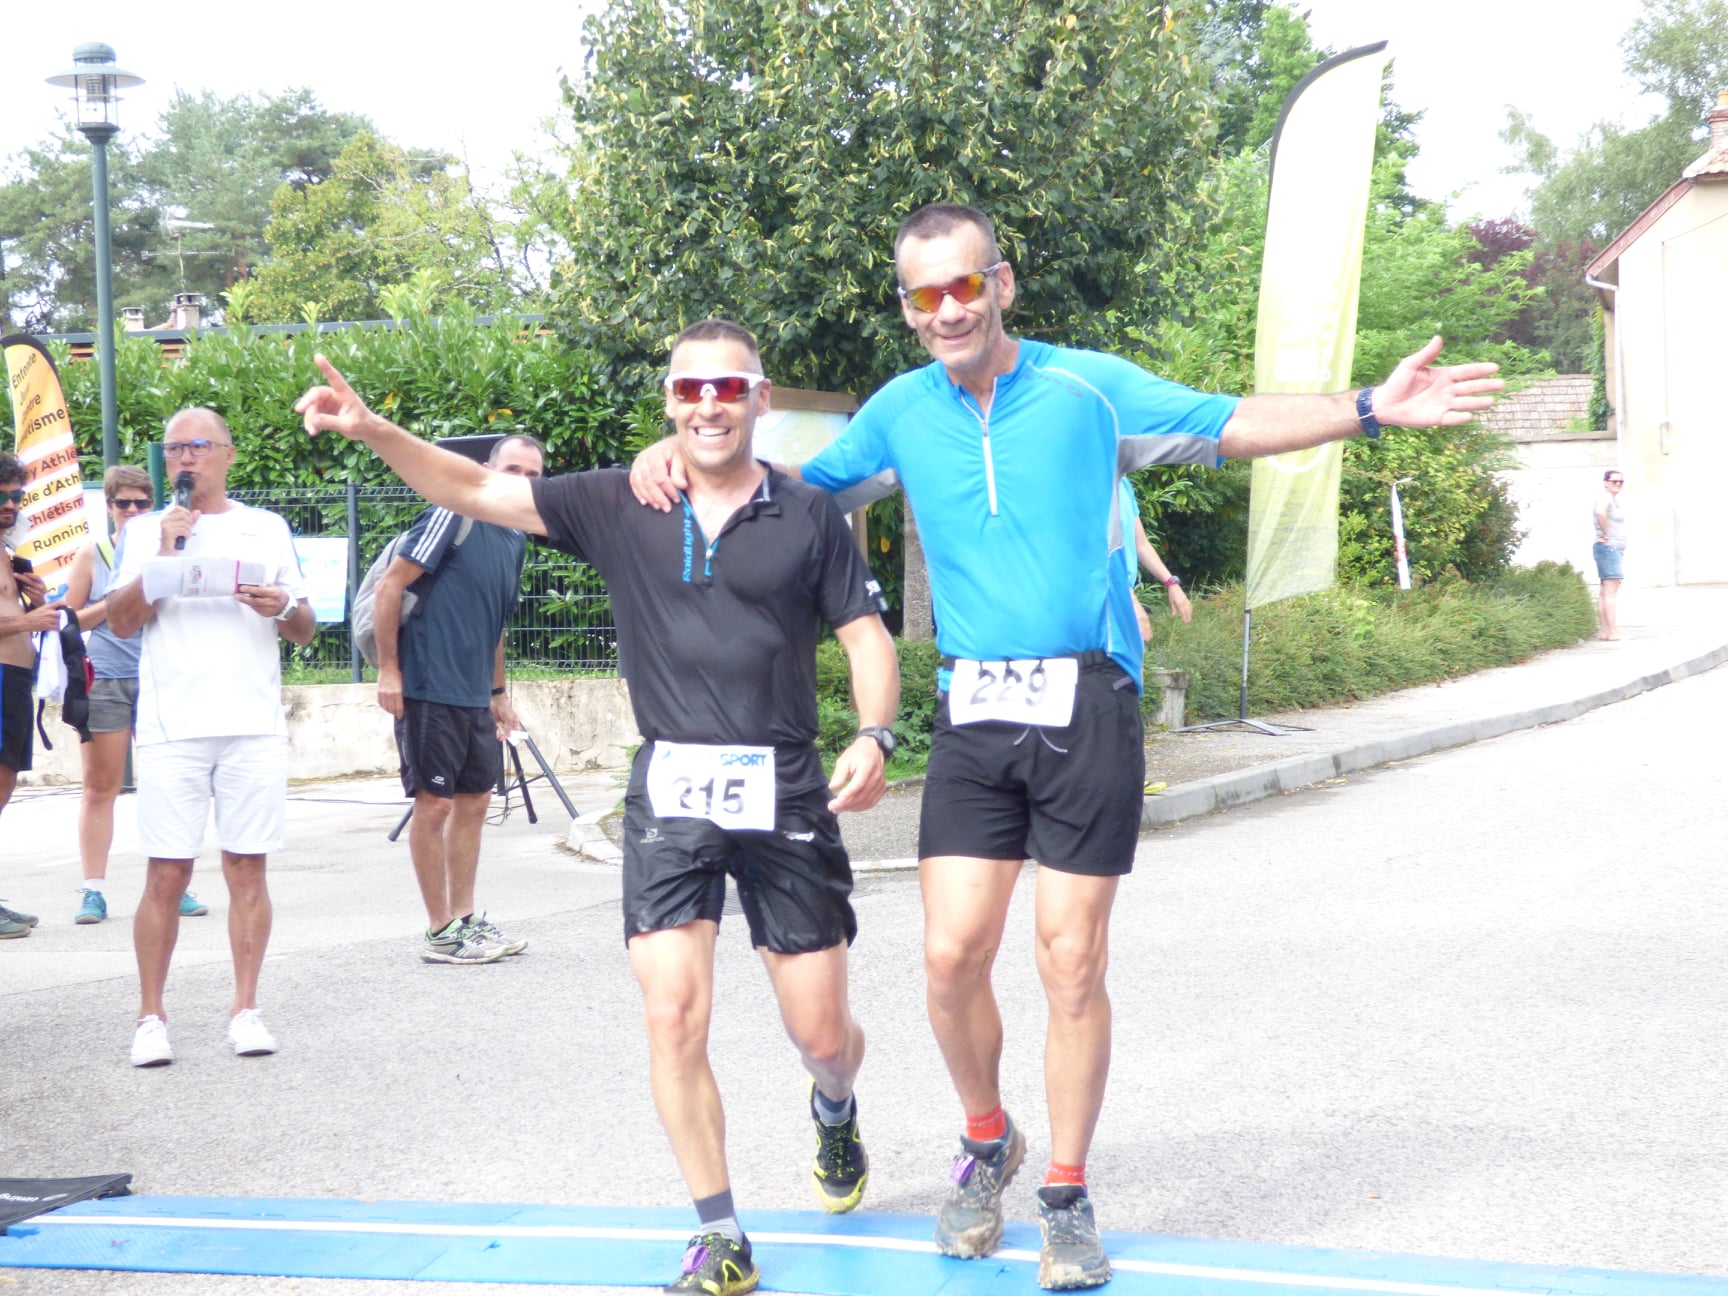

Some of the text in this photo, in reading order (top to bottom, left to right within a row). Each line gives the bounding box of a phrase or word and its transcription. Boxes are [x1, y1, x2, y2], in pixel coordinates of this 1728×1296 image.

[32, 521, 89, 552] Running
[970, 667, 1048, 707] 229
[720, 753, 768, 767] SPORT
[673, 776, 745, 815] 215
